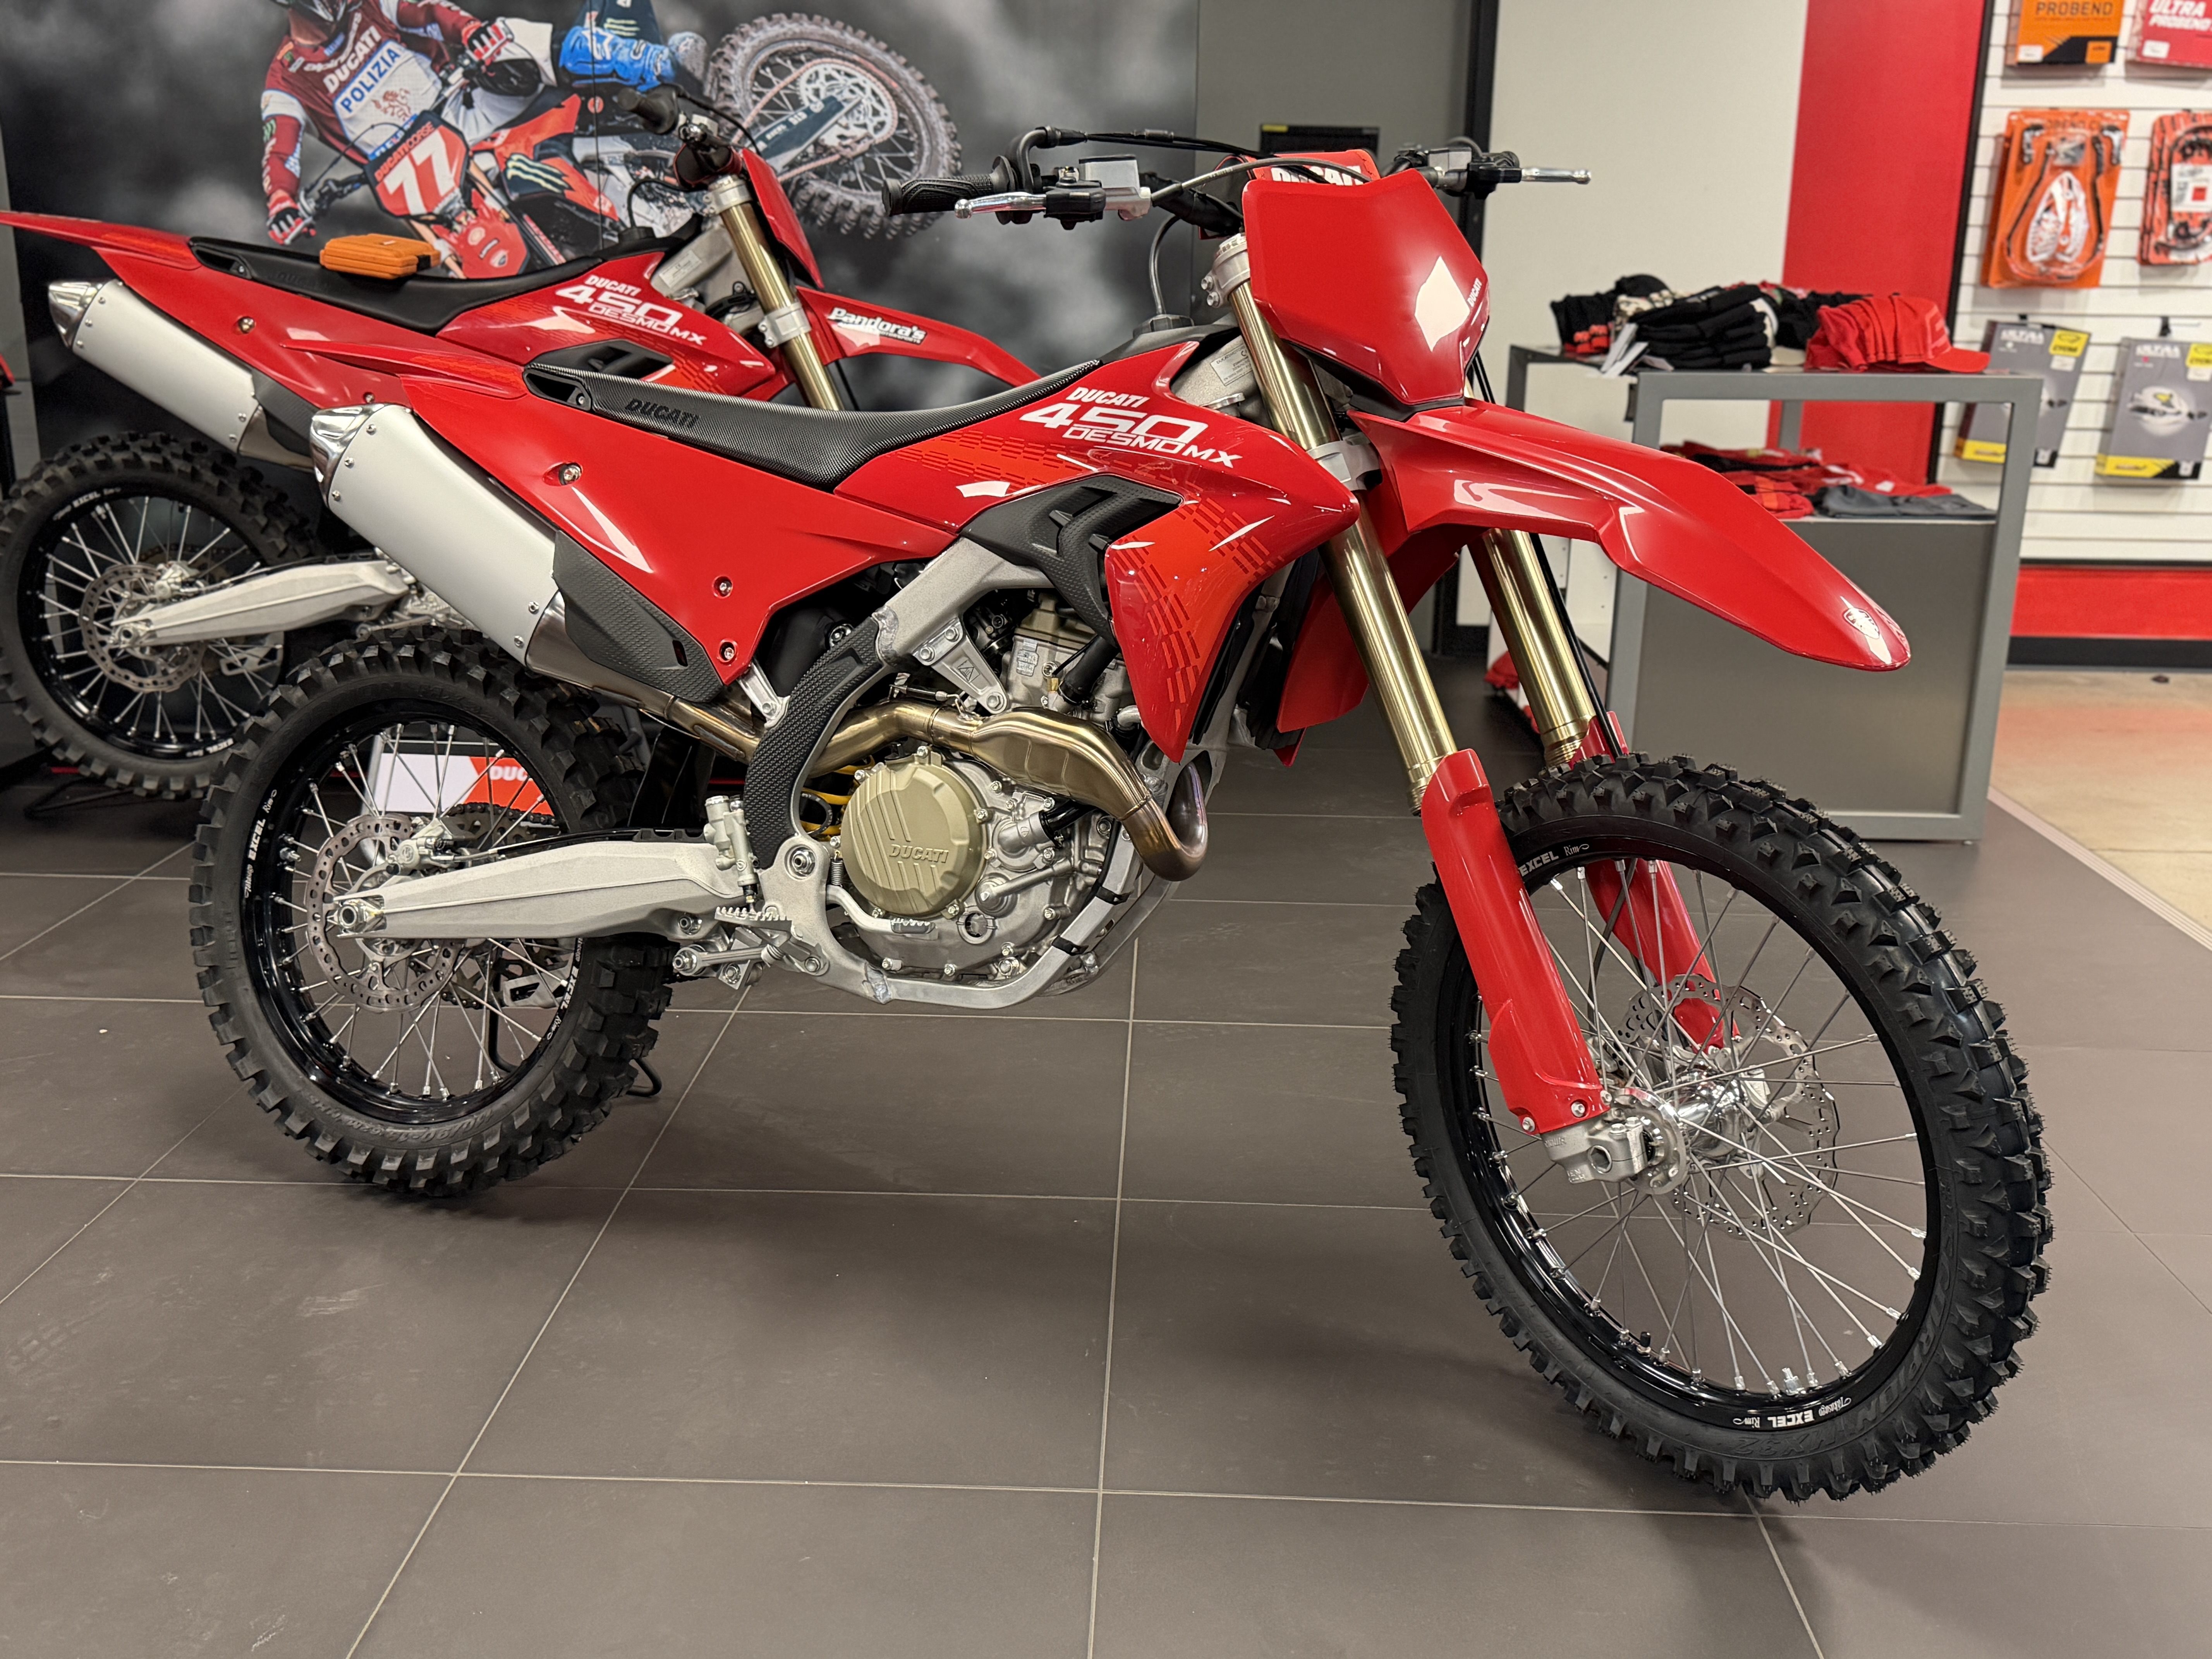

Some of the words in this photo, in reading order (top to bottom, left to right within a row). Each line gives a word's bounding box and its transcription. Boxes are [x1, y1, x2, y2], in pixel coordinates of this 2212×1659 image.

[323, 26, 381, 94] DUCATI
[340, 47, 400, 113] POLIZIA
[383, 129, 455, 215] 77
[585, 275, 641, 296] DUCATI
[1467, 277, 1482, 307] DUCATI
[555, 285, 683, 327] 450
[670, 327, 707, 345] MX
[827, 307, 927, 340] Pandora's
[1066, 386, 1149, 408] DUCATI
[625, 398, 700, 428] DUCATI
[1019, 403, 1209, 444] 450
[1062, 427, 1187, 454] DESMO
[1182, 445, 1242, 469] MX
[247, 819, 266, 860] EXCEL
[889, 844, 949, 864] DUCATI
[1518, 851, 1559, 877] EXCEL
[1767, 1410, 1814, 1428] EXCEL
